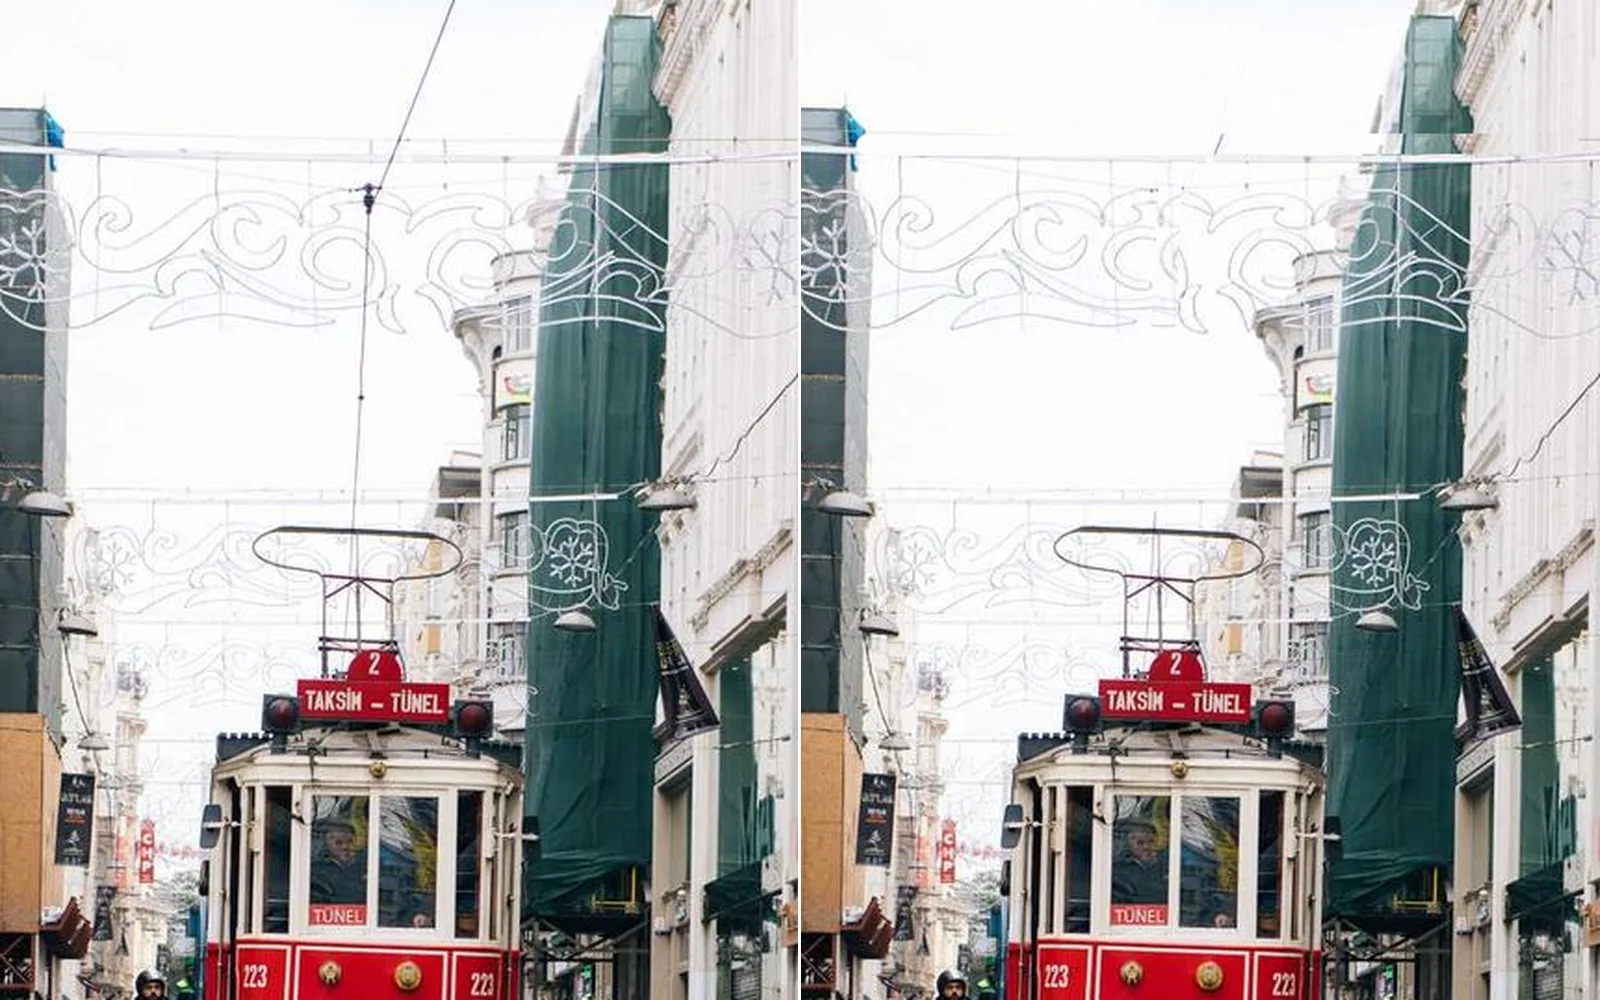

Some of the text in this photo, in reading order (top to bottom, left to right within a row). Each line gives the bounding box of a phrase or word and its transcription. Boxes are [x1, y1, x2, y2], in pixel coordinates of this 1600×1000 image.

[369, 652, 381, 675] 2
[1171, 652, 1183, 675] 2
[390, 689, 443, 714] TÜNEL
[1192, 689, 1245, 714] TÜNEL
[243, 964, 267, 988] 223
[471, 972, 495, 996] 223
[1045, 964, 1069, 988] 223
[1273, 972, 1297, 996] 223
